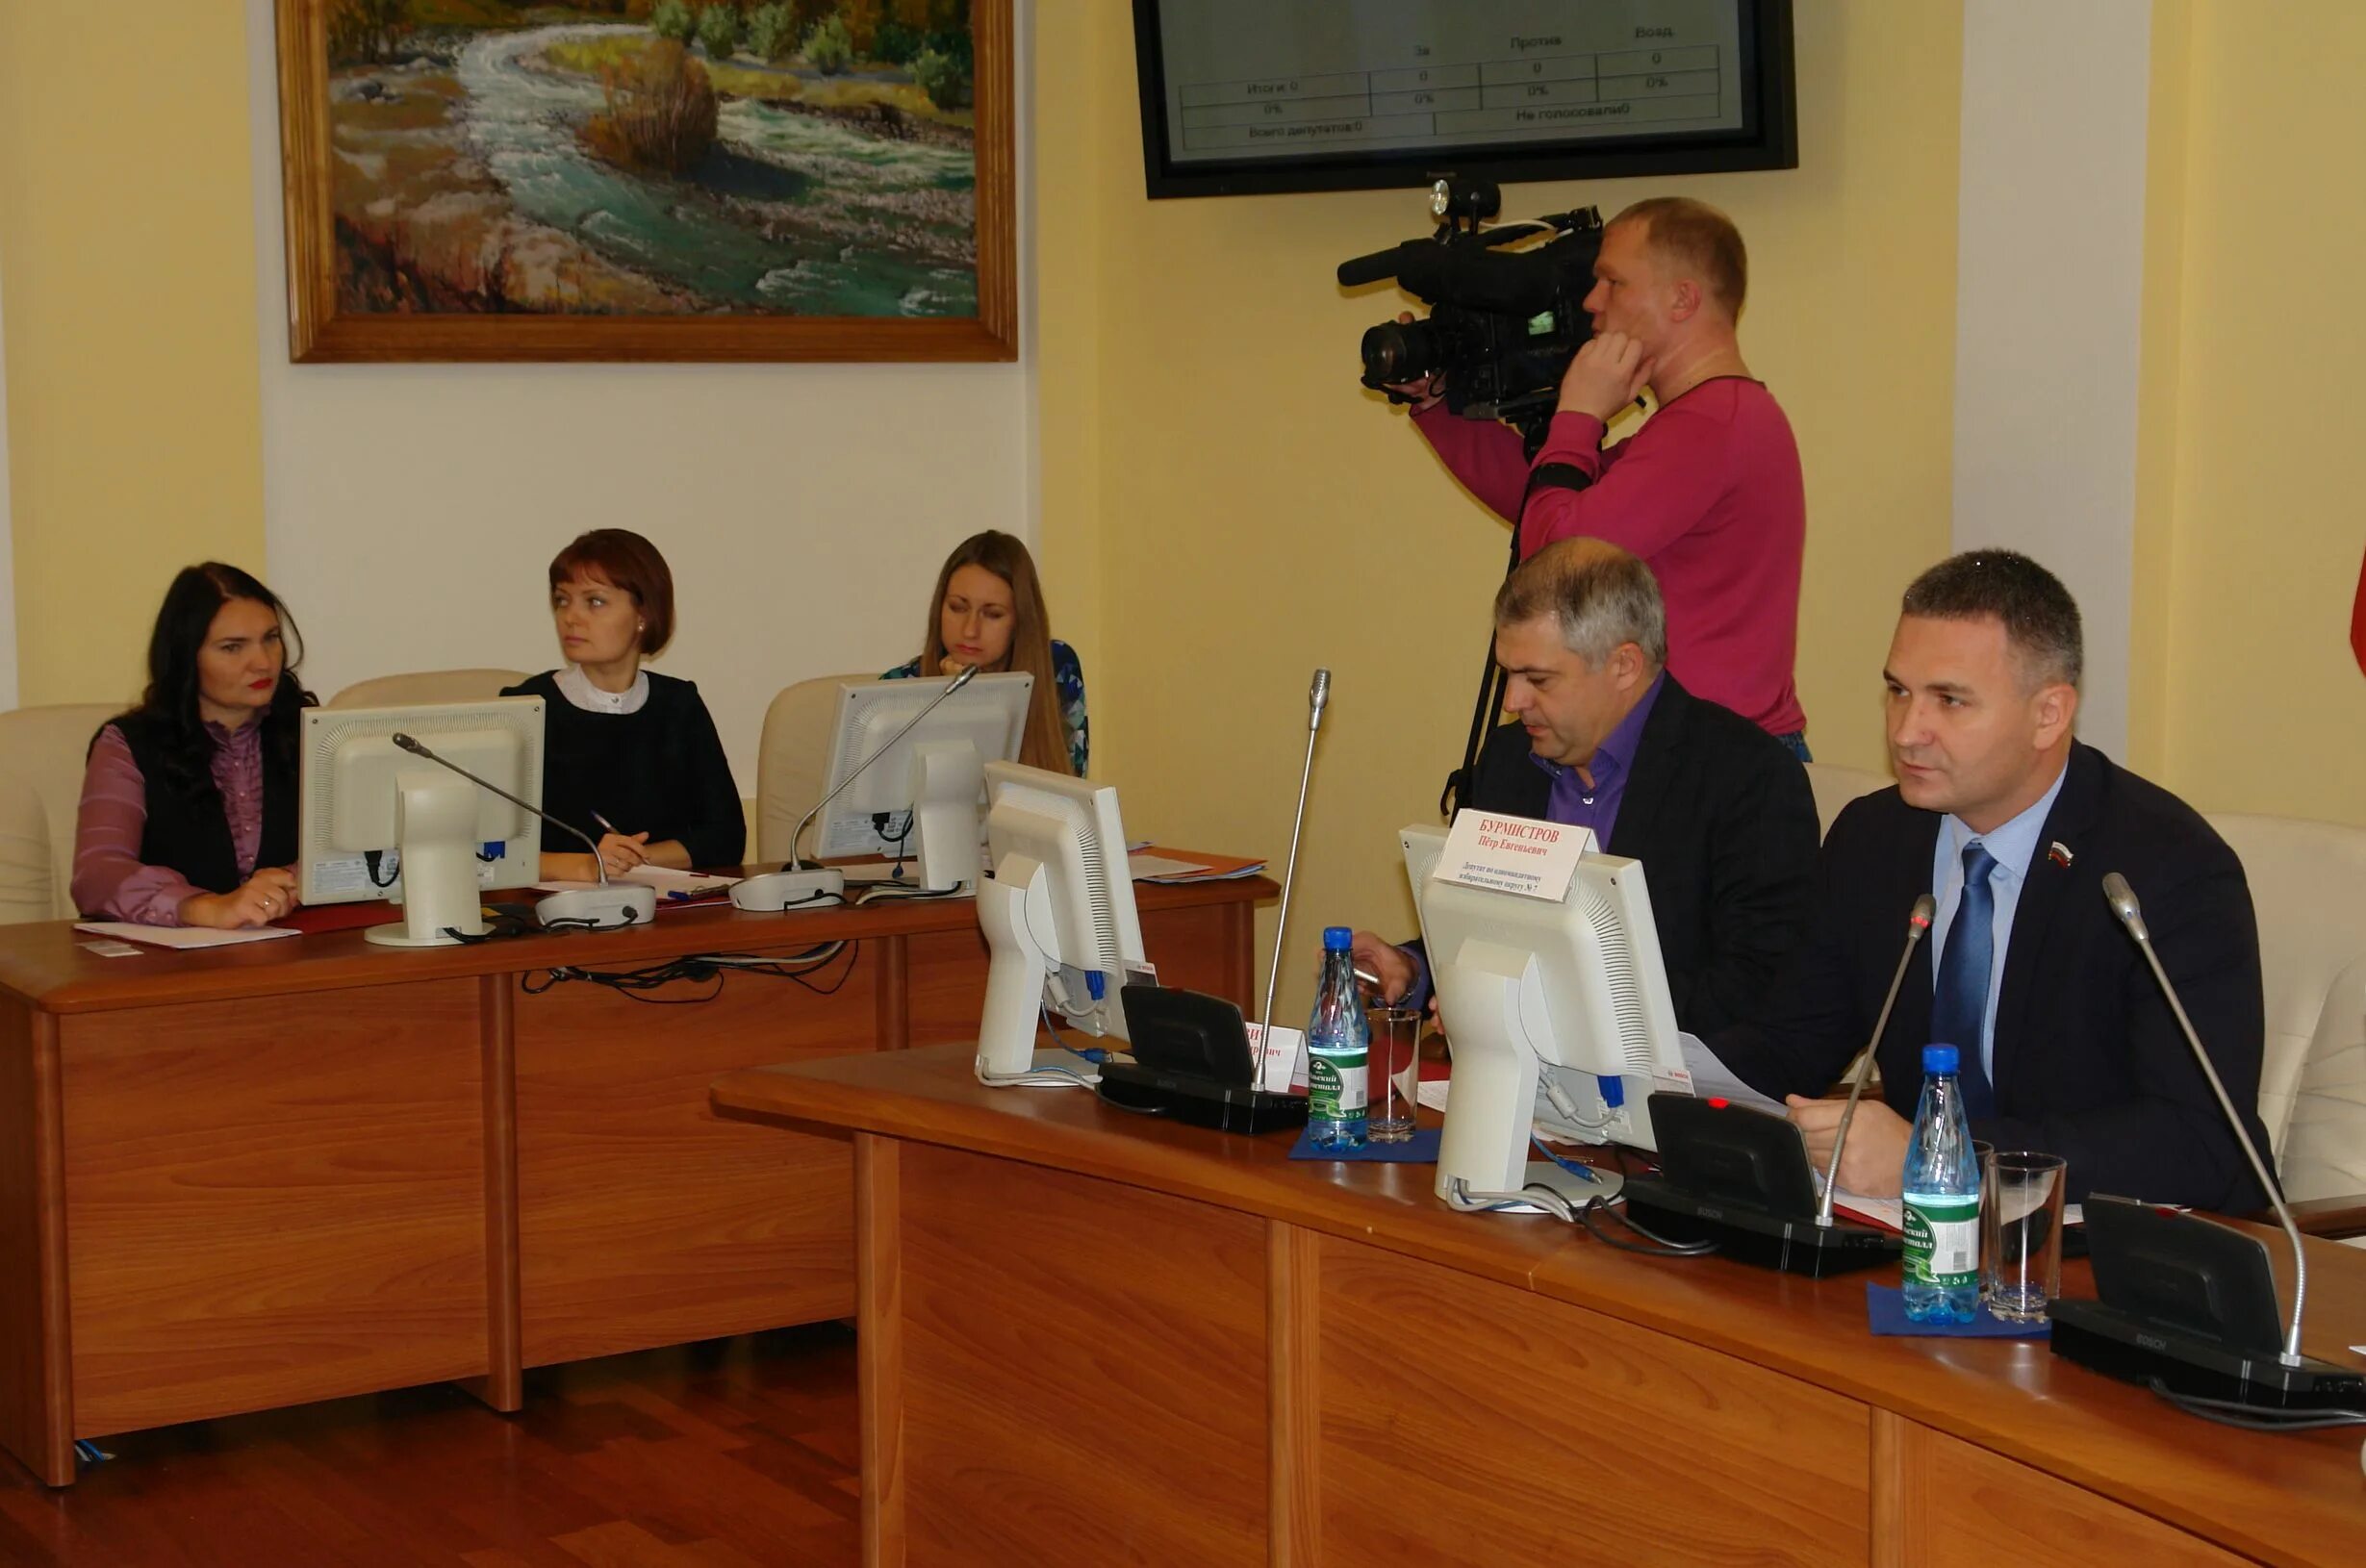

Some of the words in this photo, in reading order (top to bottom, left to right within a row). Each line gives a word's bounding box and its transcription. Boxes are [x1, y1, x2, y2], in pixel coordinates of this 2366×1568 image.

[1511, 36, 1562, 52] Против
[1414, 45, 1430, 56] За
[1652, 53, 1661, 63] 0
[1533, 63, 1541, 73] 0
[1419, 71, 1428, 82] 0
[1646, 76, 1668, 89] 0%
[1289, 81, 1298, 91] 0
[1527, 86, 1549, 97] 0%
[1414, 91, 1434, 104] 0%
[1263, 104, 1283, 114] 0%
[1517, 109, 1536, 121] Не
[1249, 125, 1285, 139] Всего
[1479, 819, 1560, 843] БУРМИСТРОВ
[1478, 835, 1499, 850] Пётр
[1500, 839, 1547, 856] Евгеньевич
[1463, 862, 1486, 873] Депутат
[1459, 873, 1503, 886] избирательному
[1504, 881, 1524, 892] округу
[2136, 1333, 2167, 1350] BOSCH
